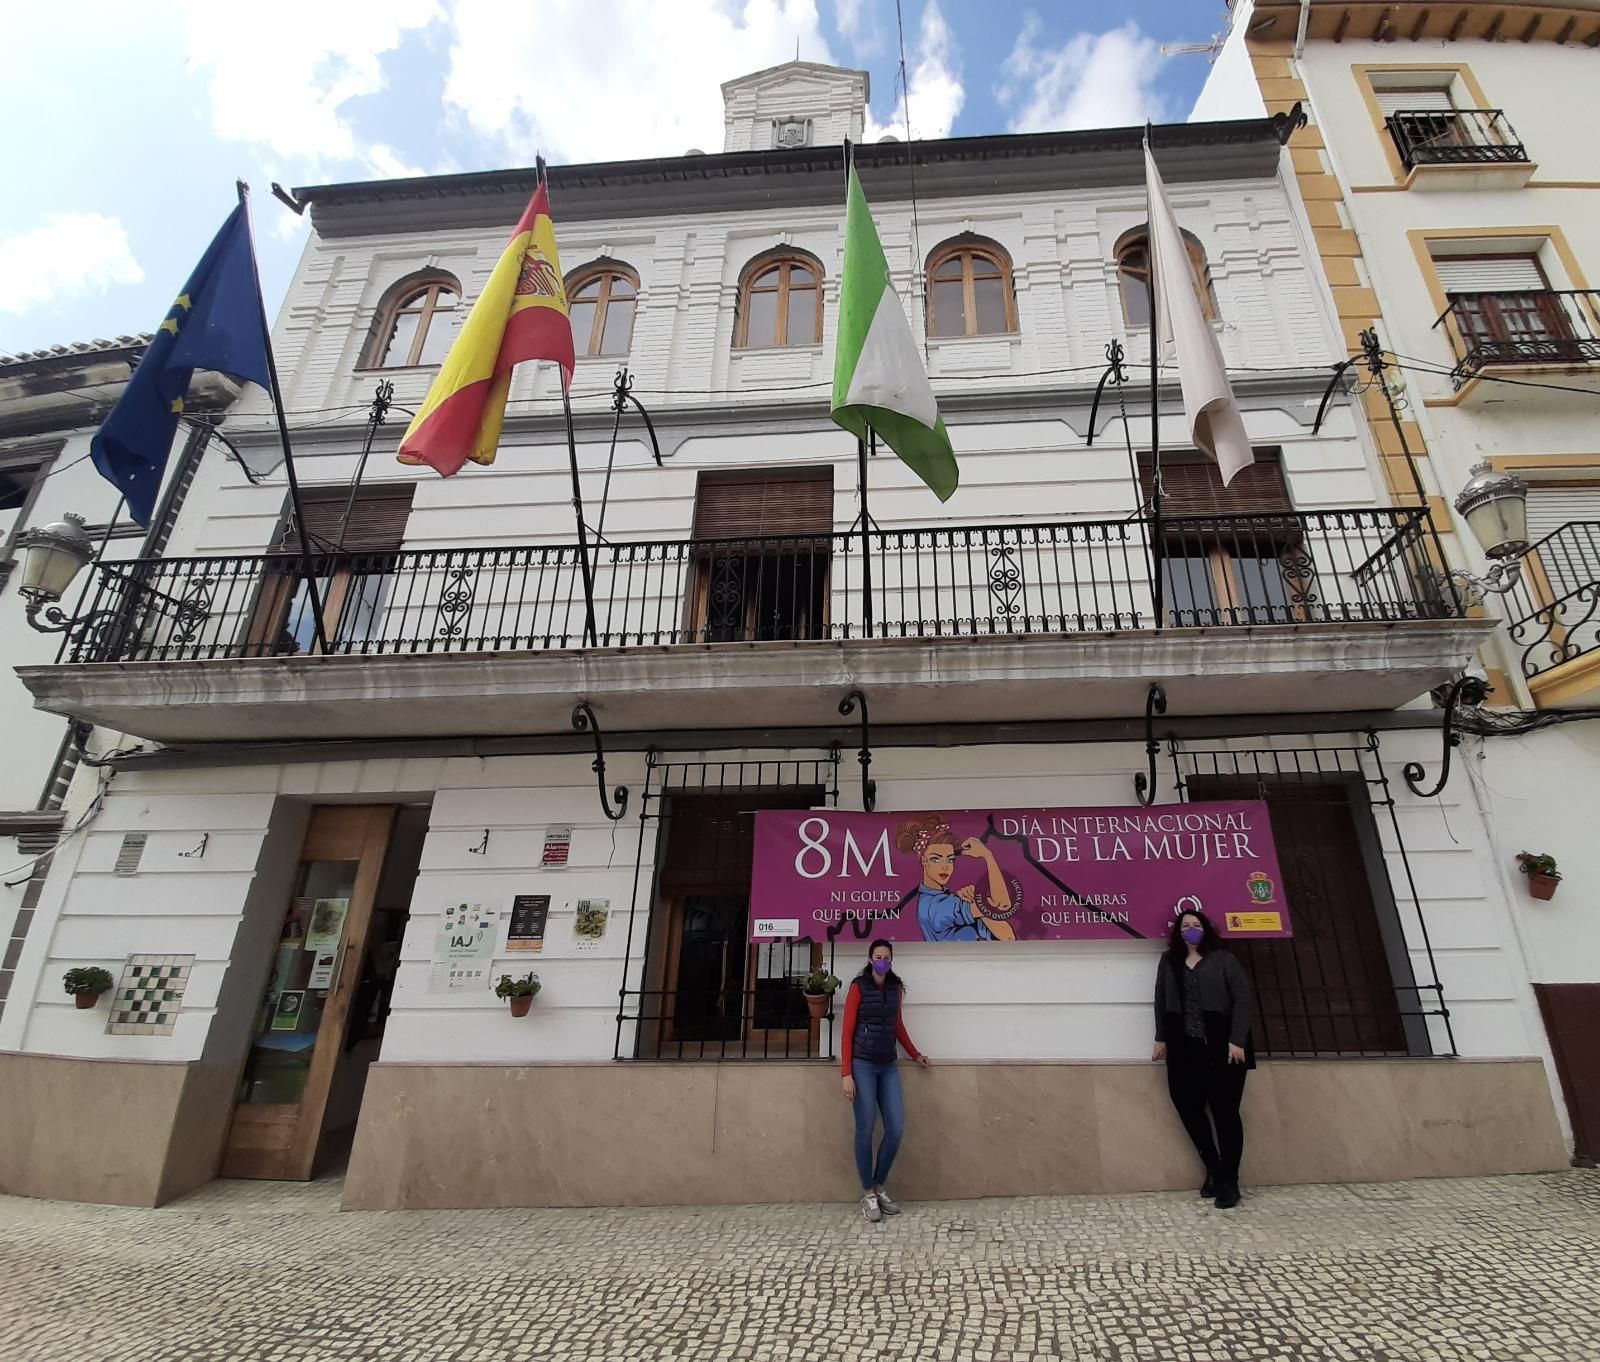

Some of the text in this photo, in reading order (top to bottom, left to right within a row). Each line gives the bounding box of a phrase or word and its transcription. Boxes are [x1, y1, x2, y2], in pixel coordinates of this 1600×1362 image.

[1002, 812, 1252, 836] DÍA INTERNACIONAL
[795, 817, 899, 879] 8M
[1034, 832, 1260, 866] DE LA MUJER
[831, 890, 901, 903] NI GOLPES
[1041, 893, 1127, 906] NI PALABRAS
[812, 908, 901, 923] QUE DUELAN
[1041, 911, 1129, 926] QUE HIERAN
[758, 923, 774, 931] 016
